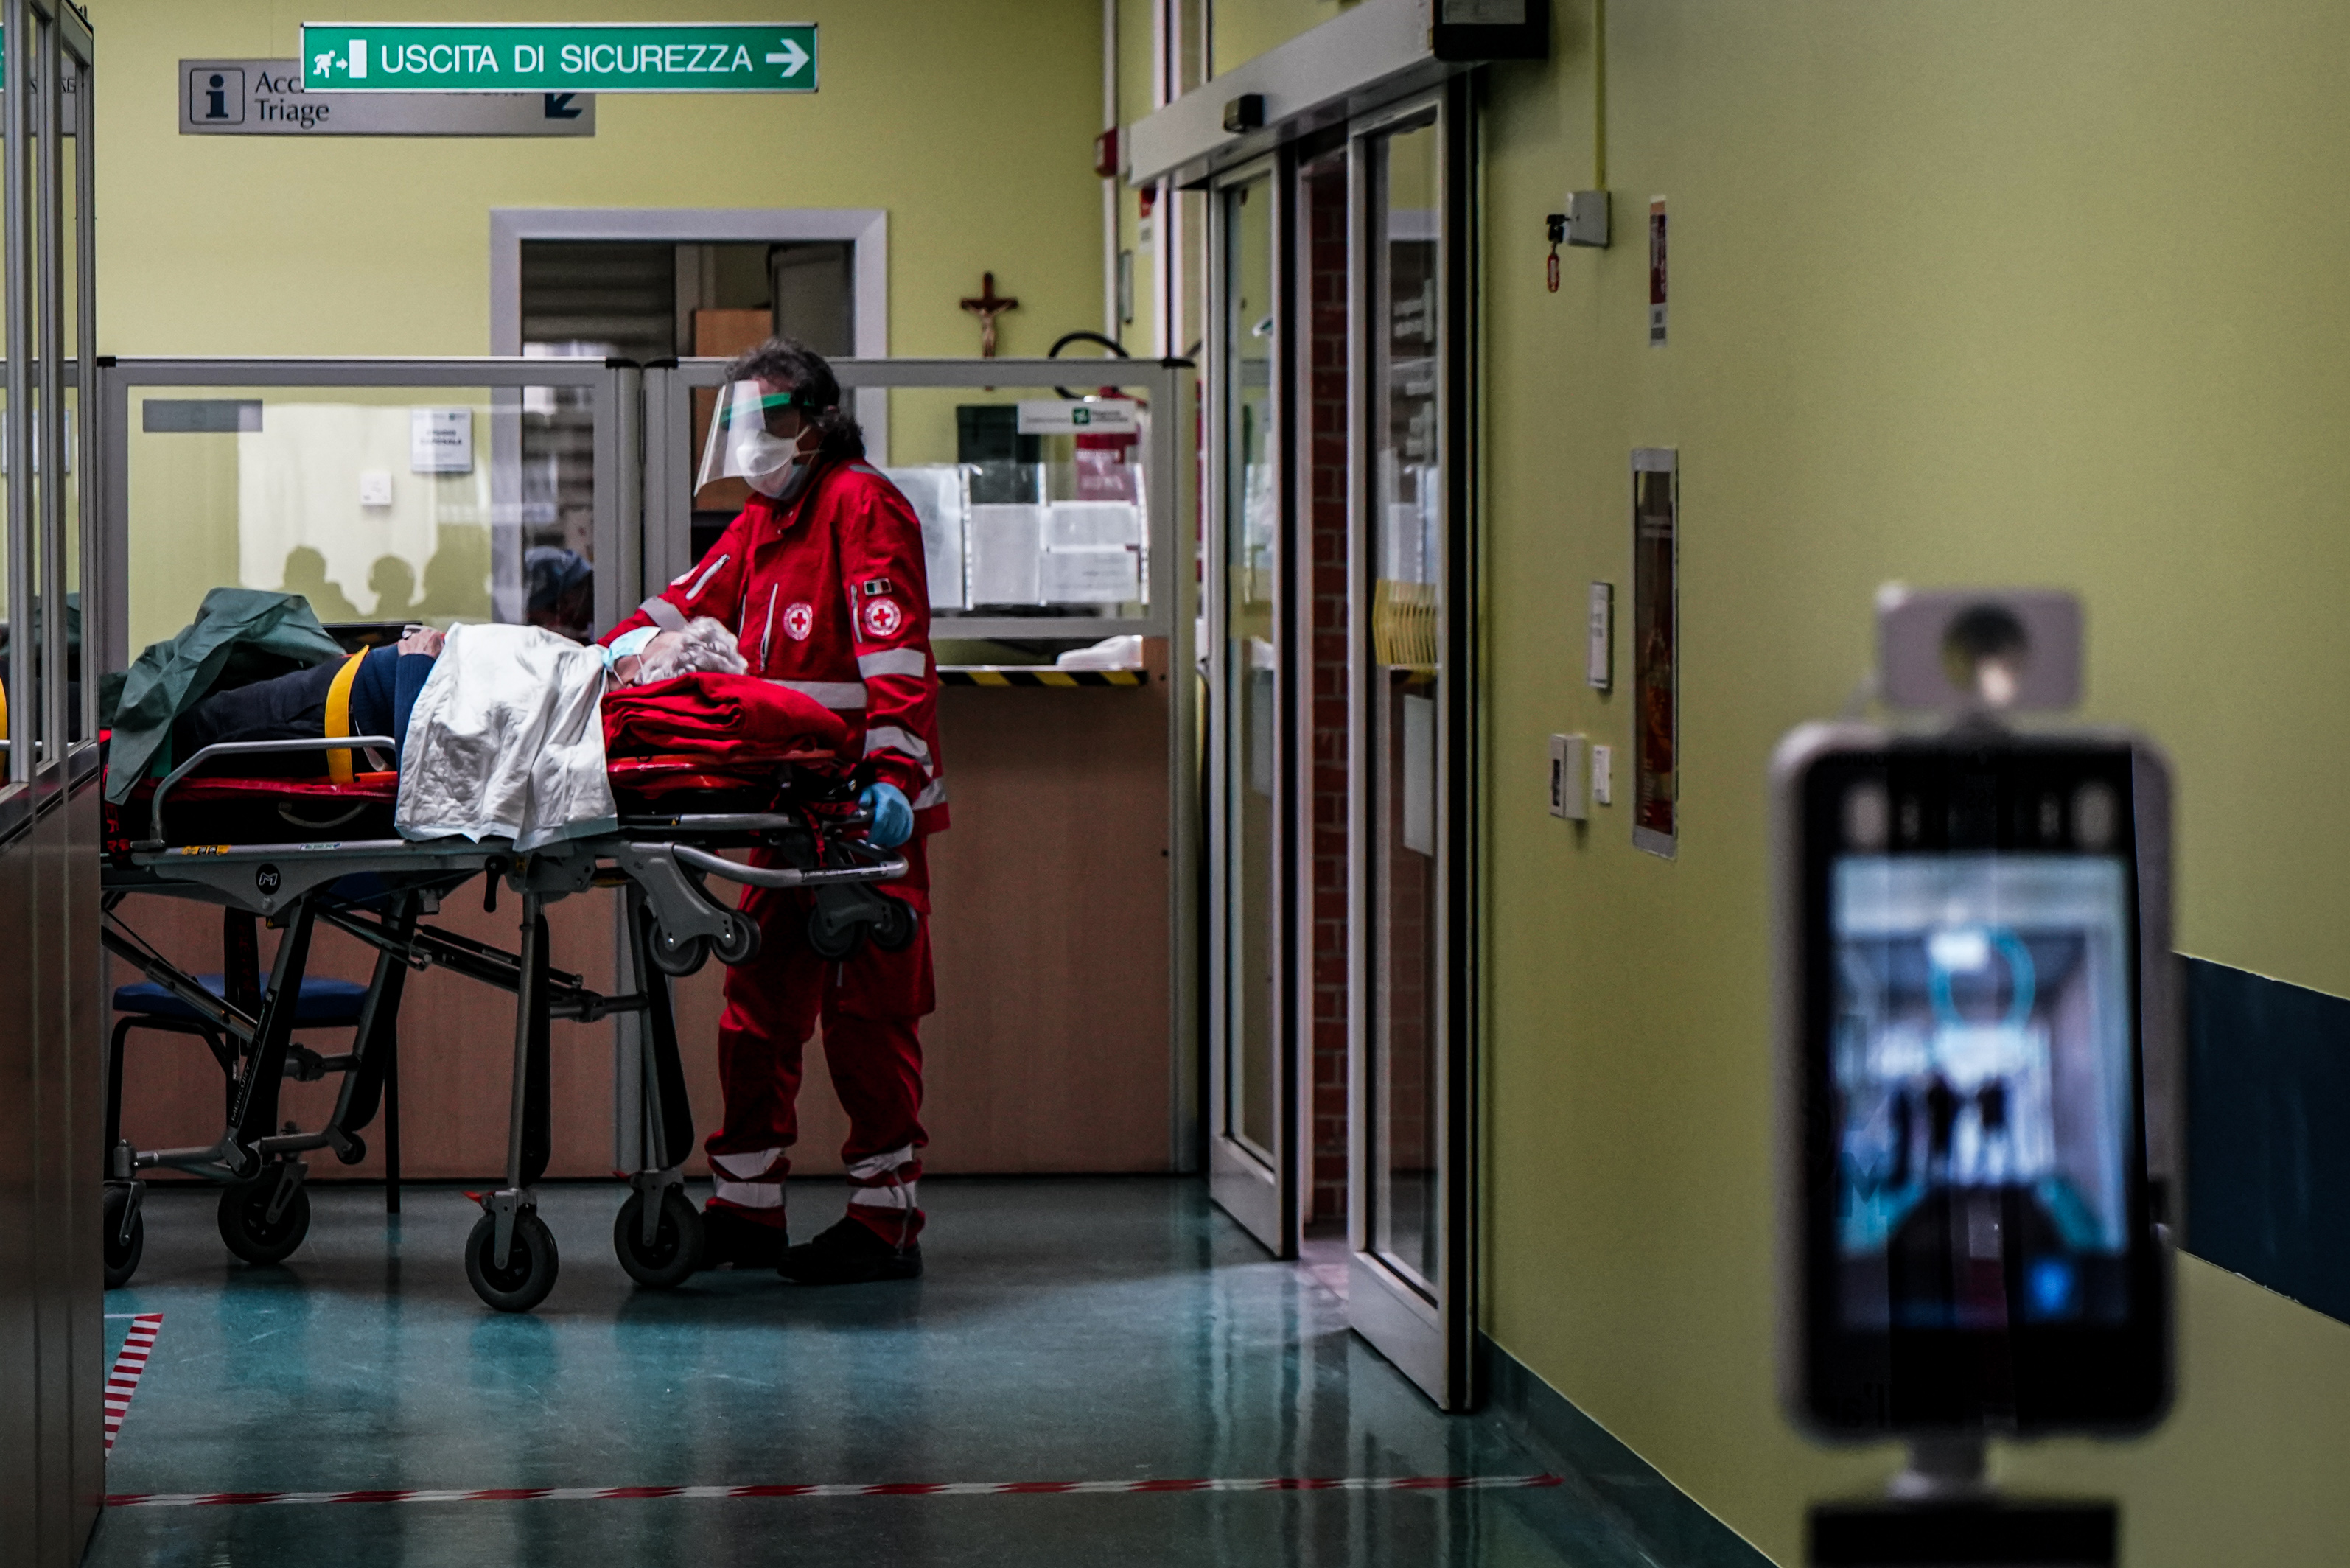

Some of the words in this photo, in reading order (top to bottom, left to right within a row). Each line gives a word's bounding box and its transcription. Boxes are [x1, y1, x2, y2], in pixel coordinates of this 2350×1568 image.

[382, 44, 499, 74] USCITA
[514, 44, 545, 73] DI
[560, 43, 753, 74] SICUREZZA
[255, 71, 305, 94] Acc
[254, 97, 330, 129] Triage
